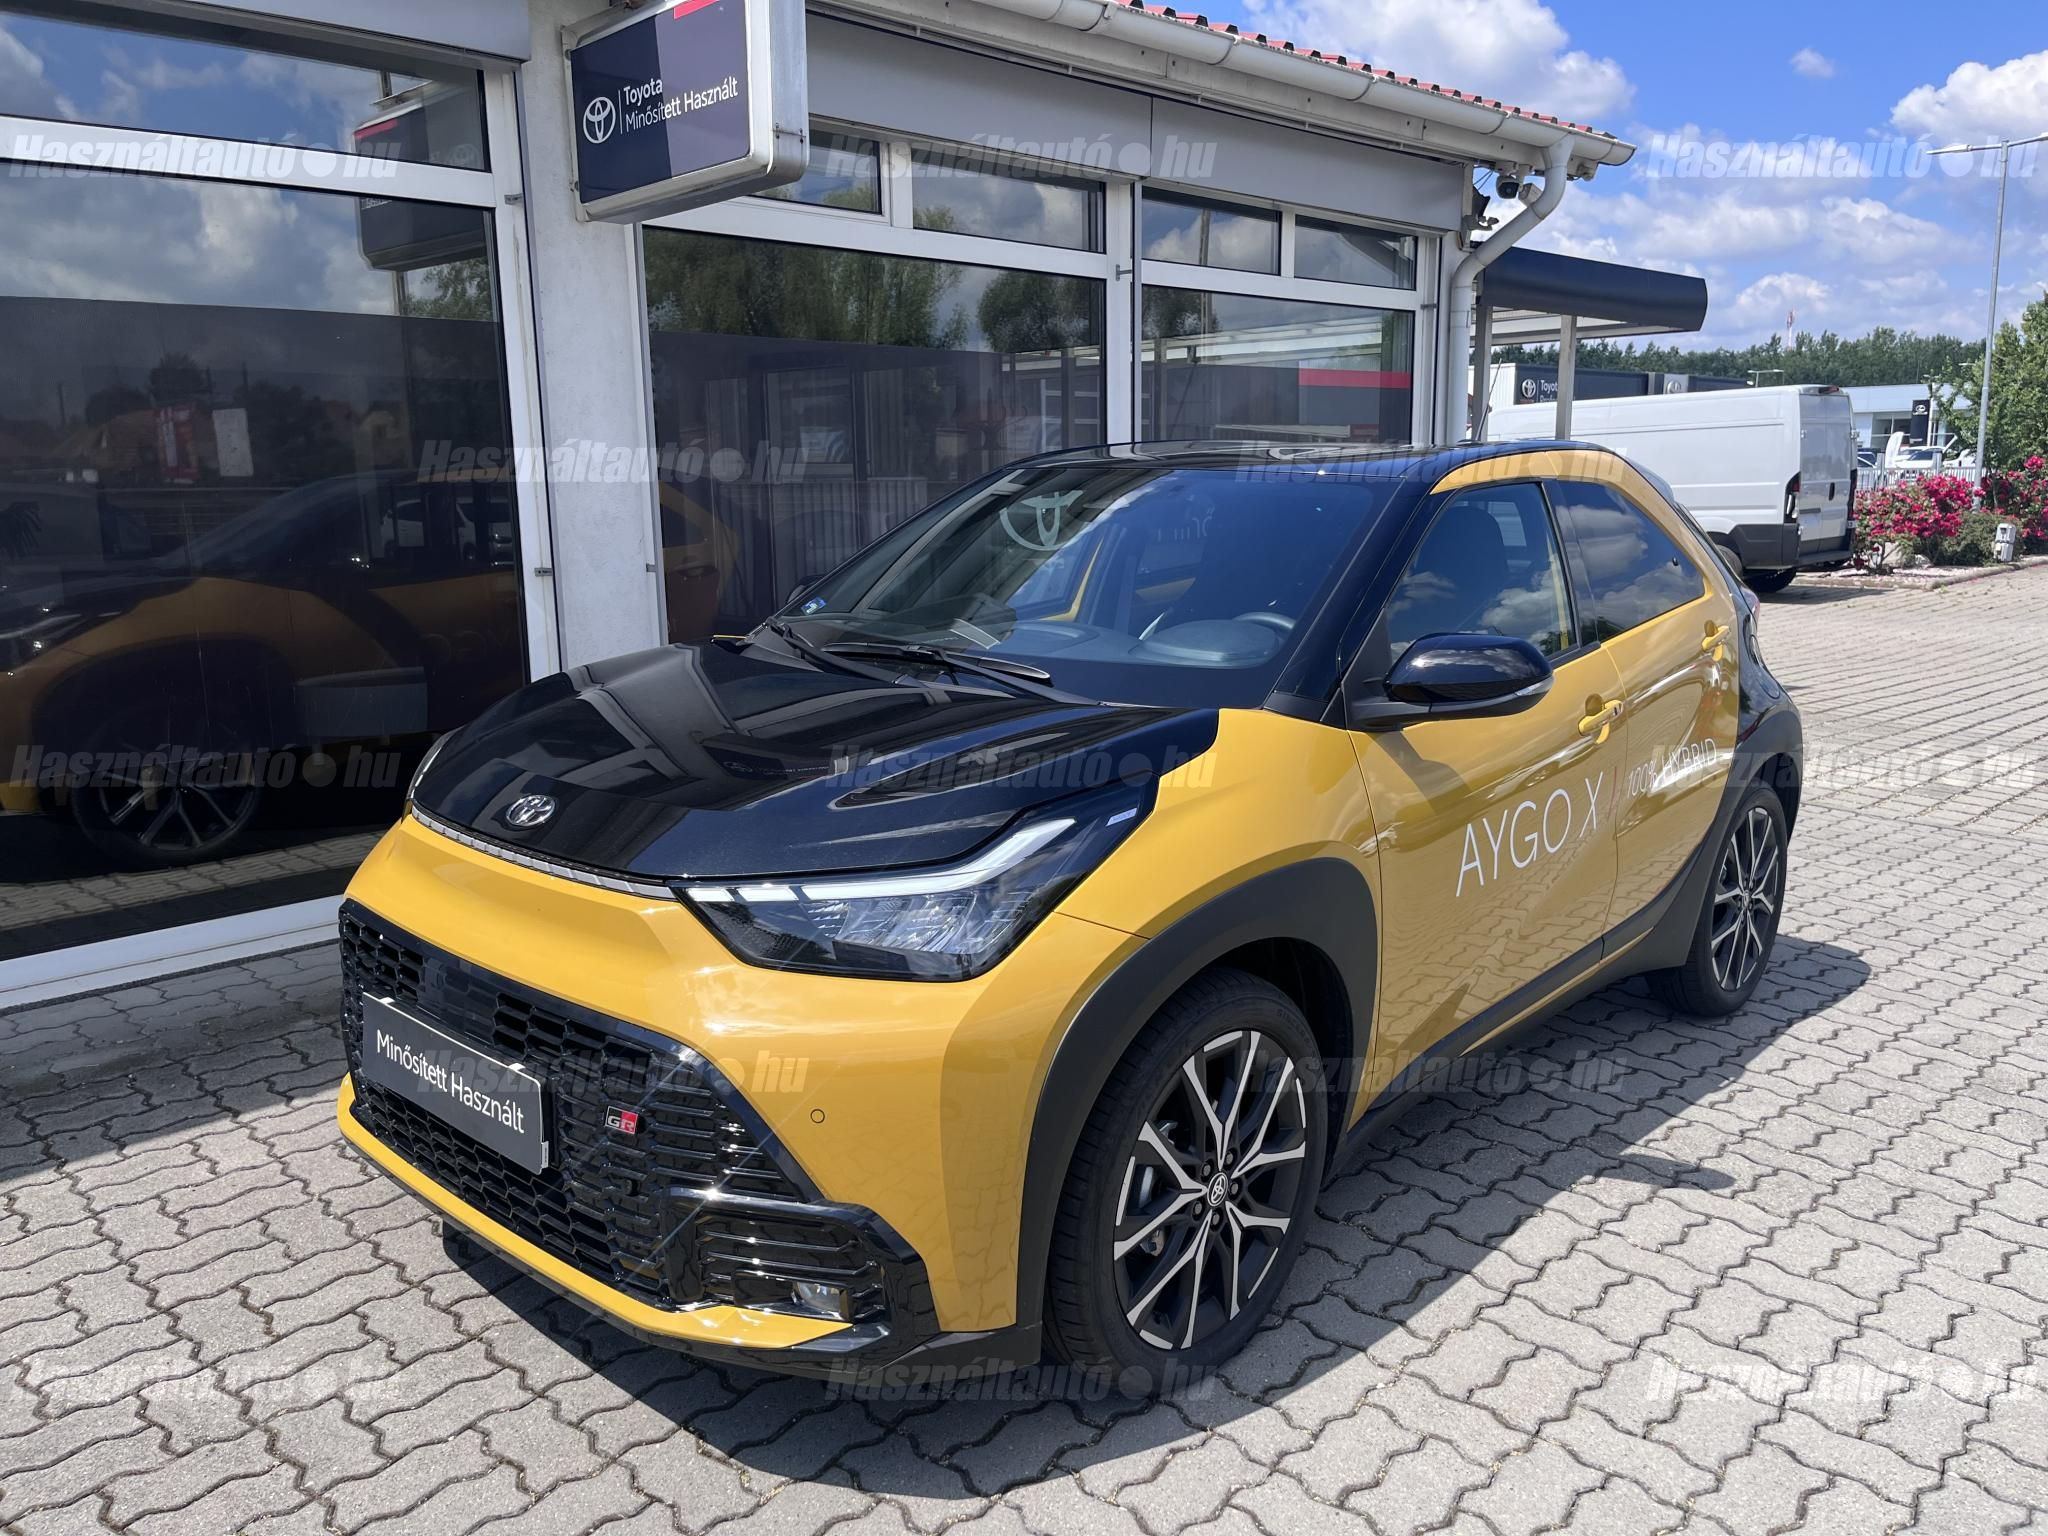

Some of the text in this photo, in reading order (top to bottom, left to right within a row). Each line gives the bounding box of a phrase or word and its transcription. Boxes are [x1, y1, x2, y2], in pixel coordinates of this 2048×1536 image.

[623, 78, 663, 107] Toyota
[625, 76, 739, 133] Minősített Használt
[1540, 379, 1559, 394] Toyot
[1455, 736, 1717, 898] AYGO X 100% HYBRID
[376, 1029, 525, 1134] Minősített Használt
[607, 1115, 634, 1132] GR
